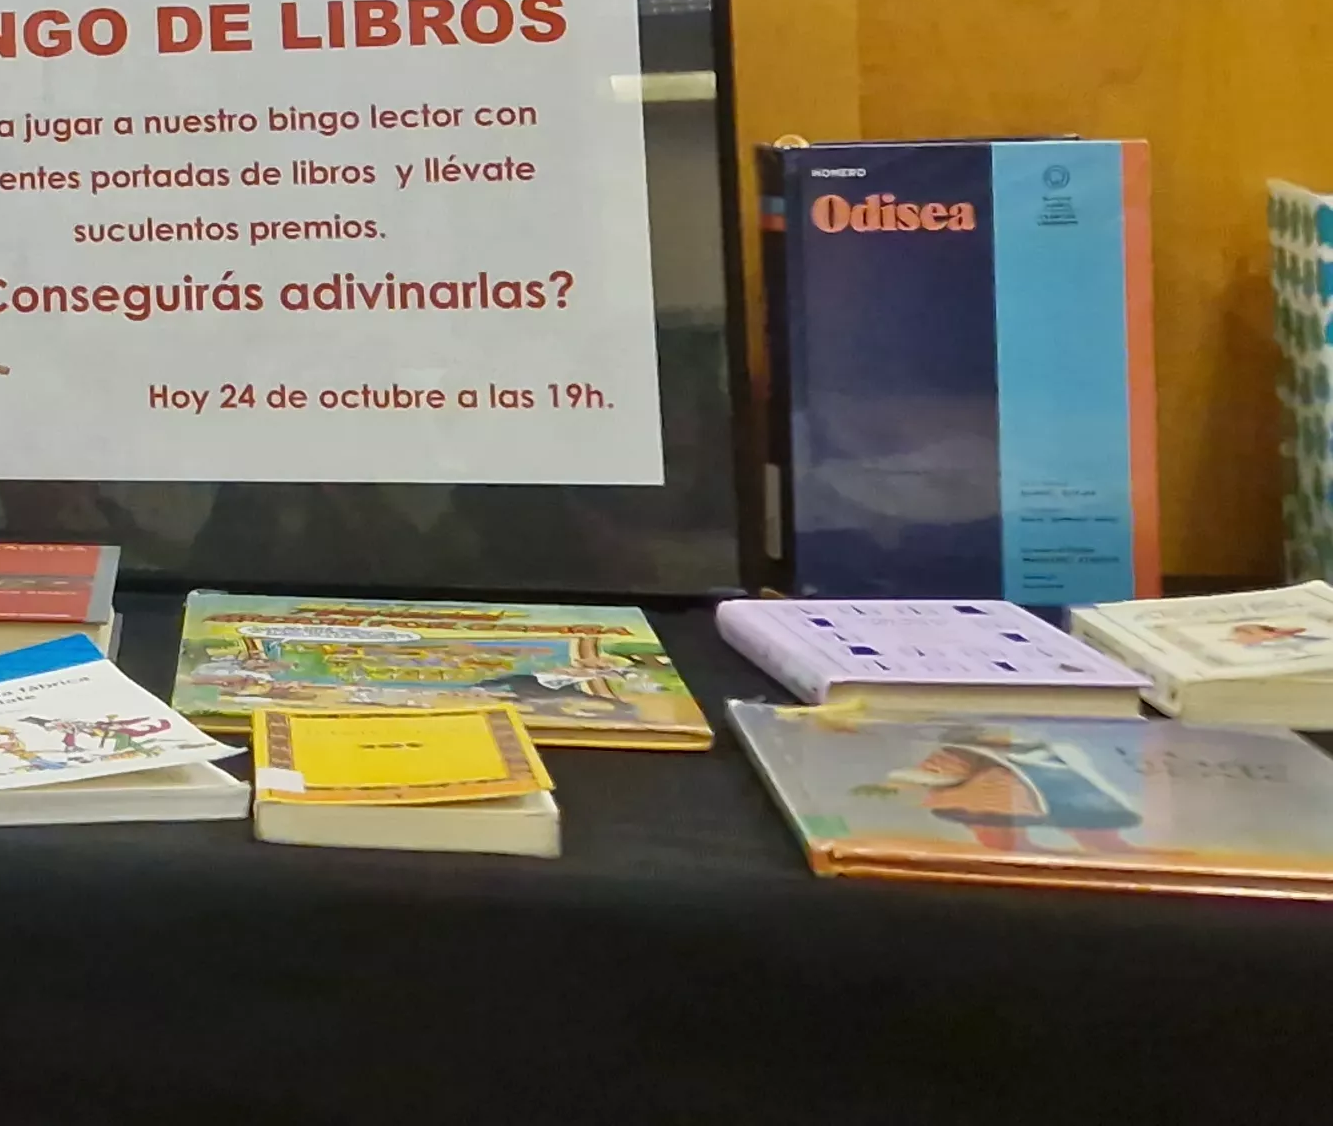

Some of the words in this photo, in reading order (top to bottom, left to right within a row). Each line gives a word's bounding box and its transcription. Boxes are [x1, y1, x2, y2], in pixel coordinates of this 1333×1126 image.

[156, 3, 253, 55] DE
[25, 117, 103, 144] jugar
[113, 117, 134, 135] a
[144, 110, 259, 134] nuestro
[268, 111, 360, 137] bingo
[371, 105, 461, 129] lector
[475, 106, 536, 127] con
[91, 165, 230, 191] portadas
[240, 164, 282, 187] de
[293, 161, 377, 186] libros
[397, 167, 413, 187] y
[425, 158, 535, 184] llévate
[75, 219, 239, 243] suculentos
[249, 220, 387, 244] premios.
[811, 193, 976, 234] Odisea
[279, 270, 574, 312] adivinarlas?
[148, 387, 207, 411] Hoy
[220, 383, 258, 410] 24
[267, 386, 308, 410] de
[320, 386, 447, 410] octubre
[457, 389, 478, 409] a
[489, 389, 535, 409] las
[551, 383, 615, 409] 19h.
